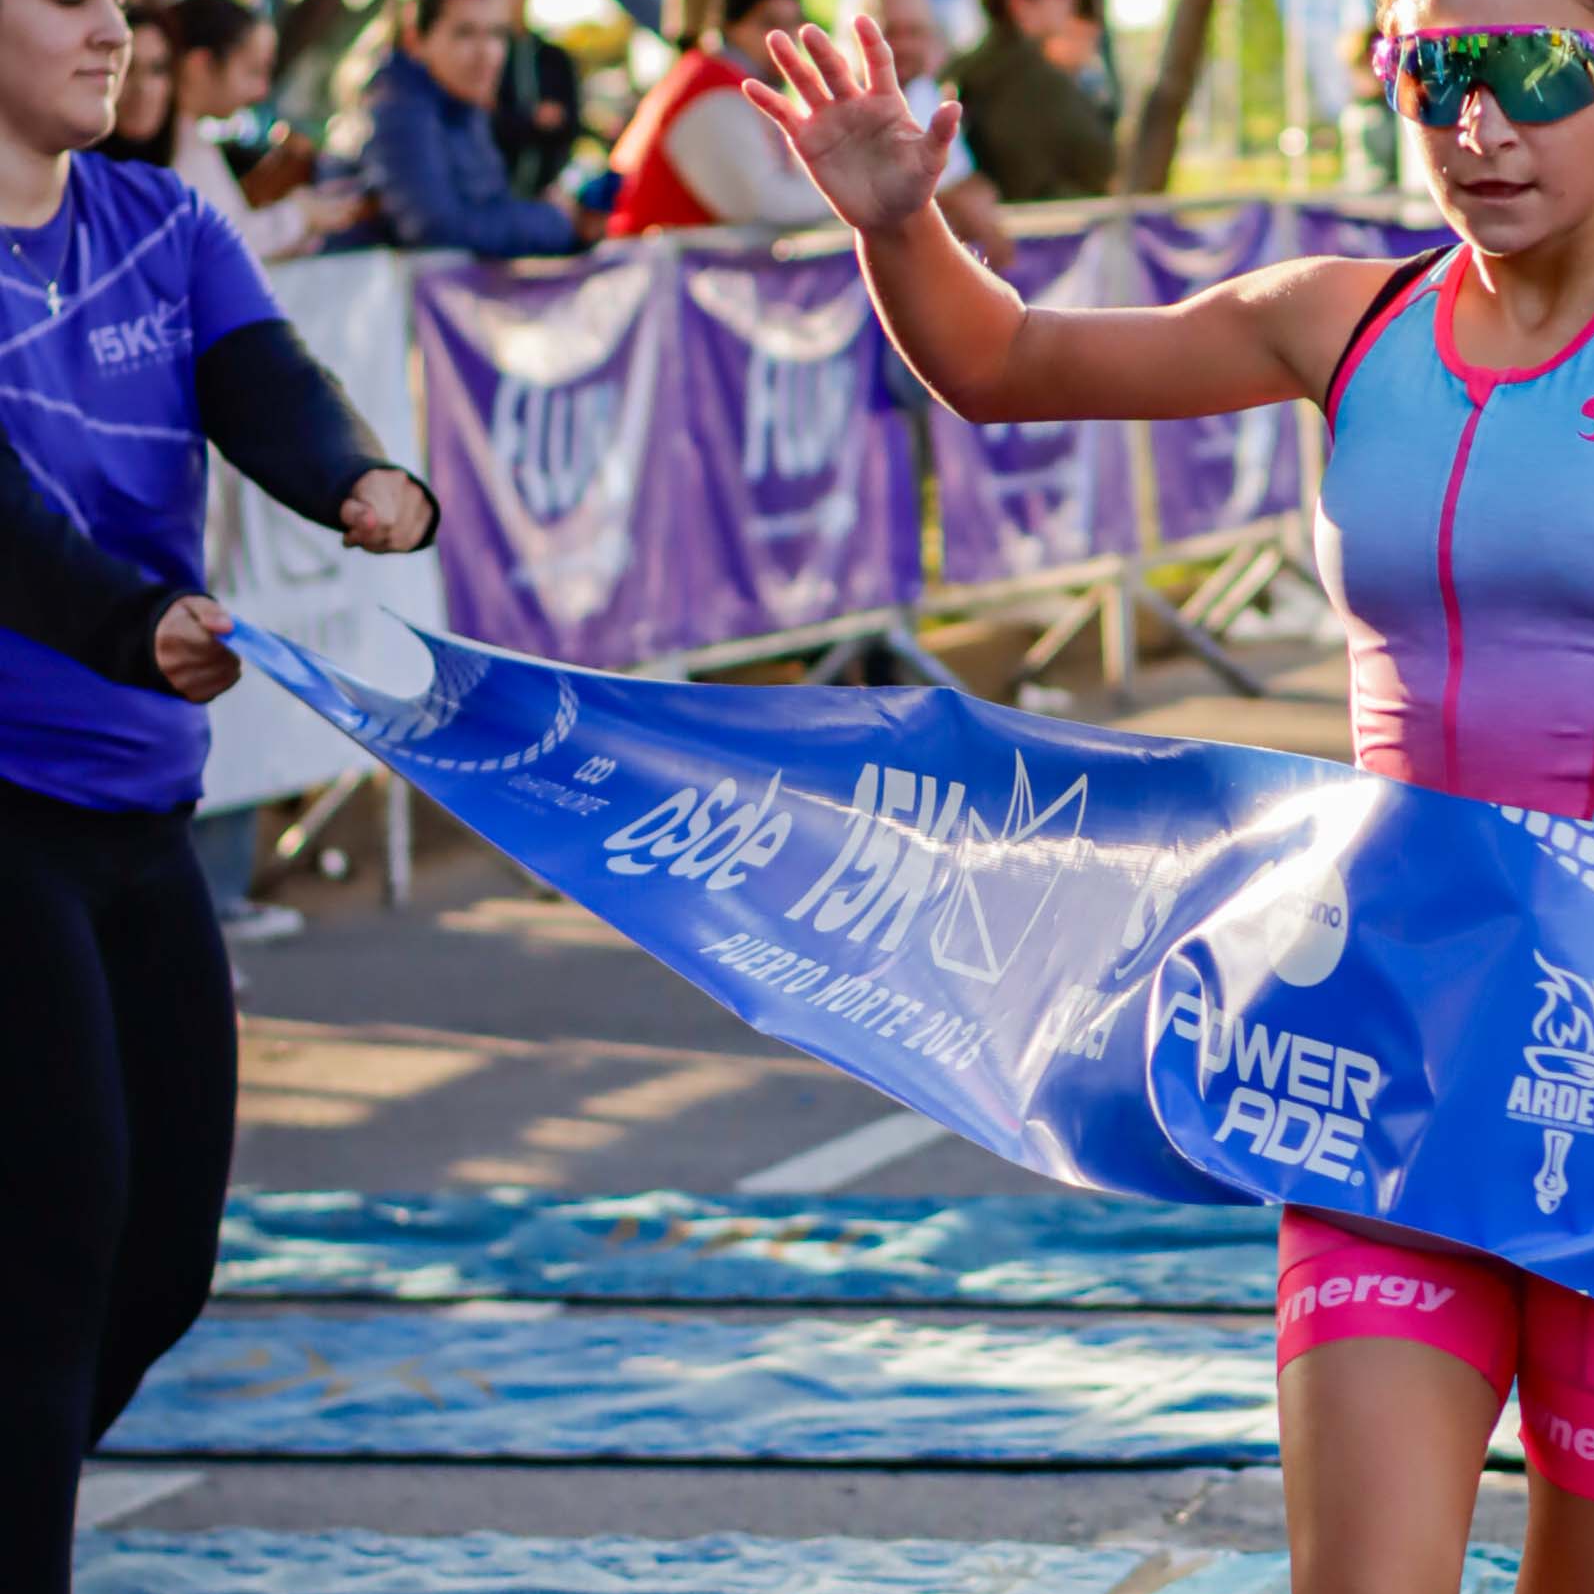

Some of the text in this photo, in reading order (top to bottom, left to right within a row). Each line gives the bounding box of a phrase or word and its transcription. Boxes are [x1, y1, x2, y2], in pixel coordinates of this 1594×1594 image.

[699, 932, 830, 993] PUERTO
[804, 973, 924, 1038] NORTE
[902, 1011, 993, 1071] 2026
[1154, 991, 1381, 1121] POWER
